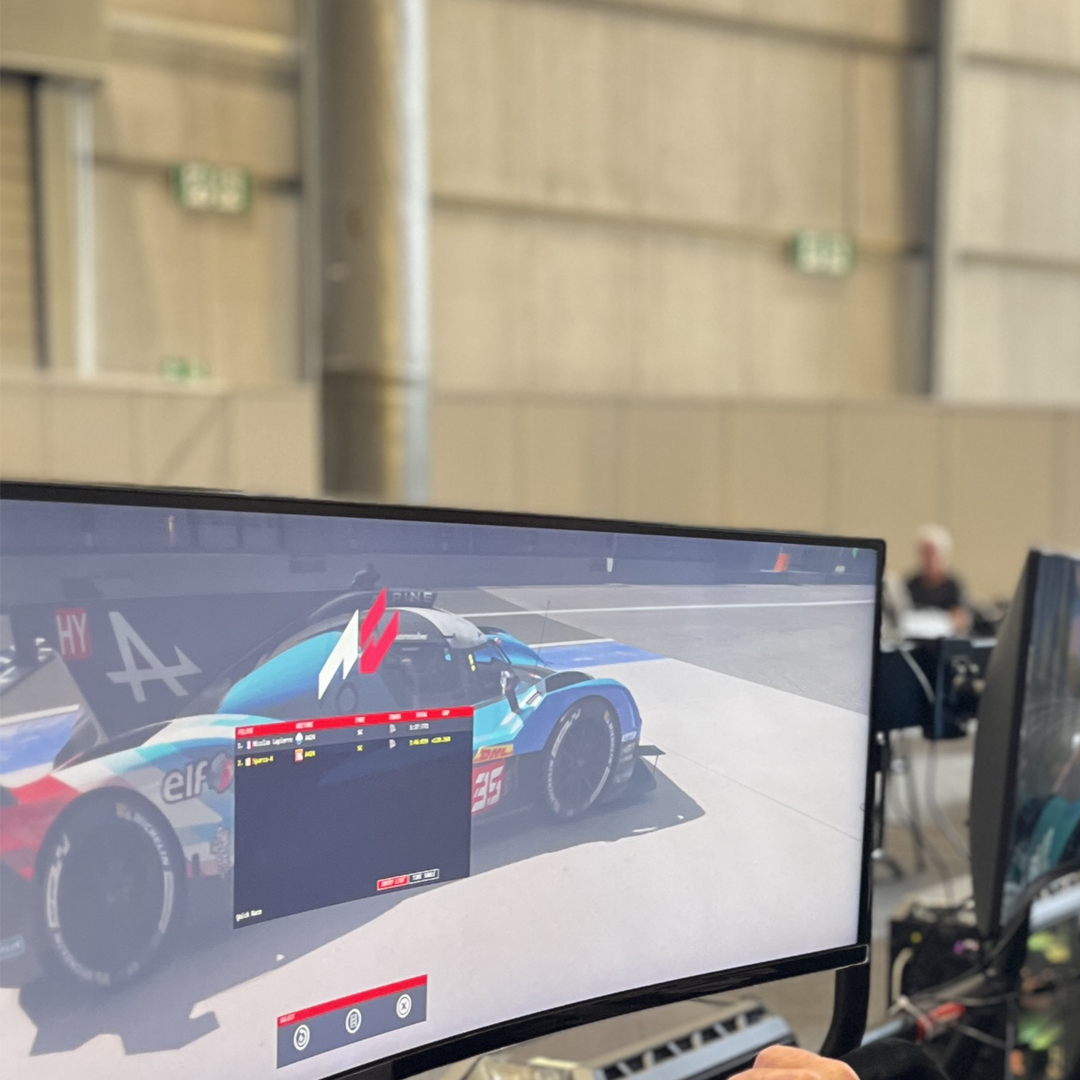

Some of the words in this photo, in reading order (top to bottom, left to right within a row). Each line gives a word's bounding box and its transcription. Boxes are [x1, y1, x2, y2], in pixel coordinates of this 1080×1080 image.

[57, 613, 87, 655] HY
[478, 746, 510, 761] DHL
[163, 760, 208, 802] elf
[471, 765, 504, 812] 35
